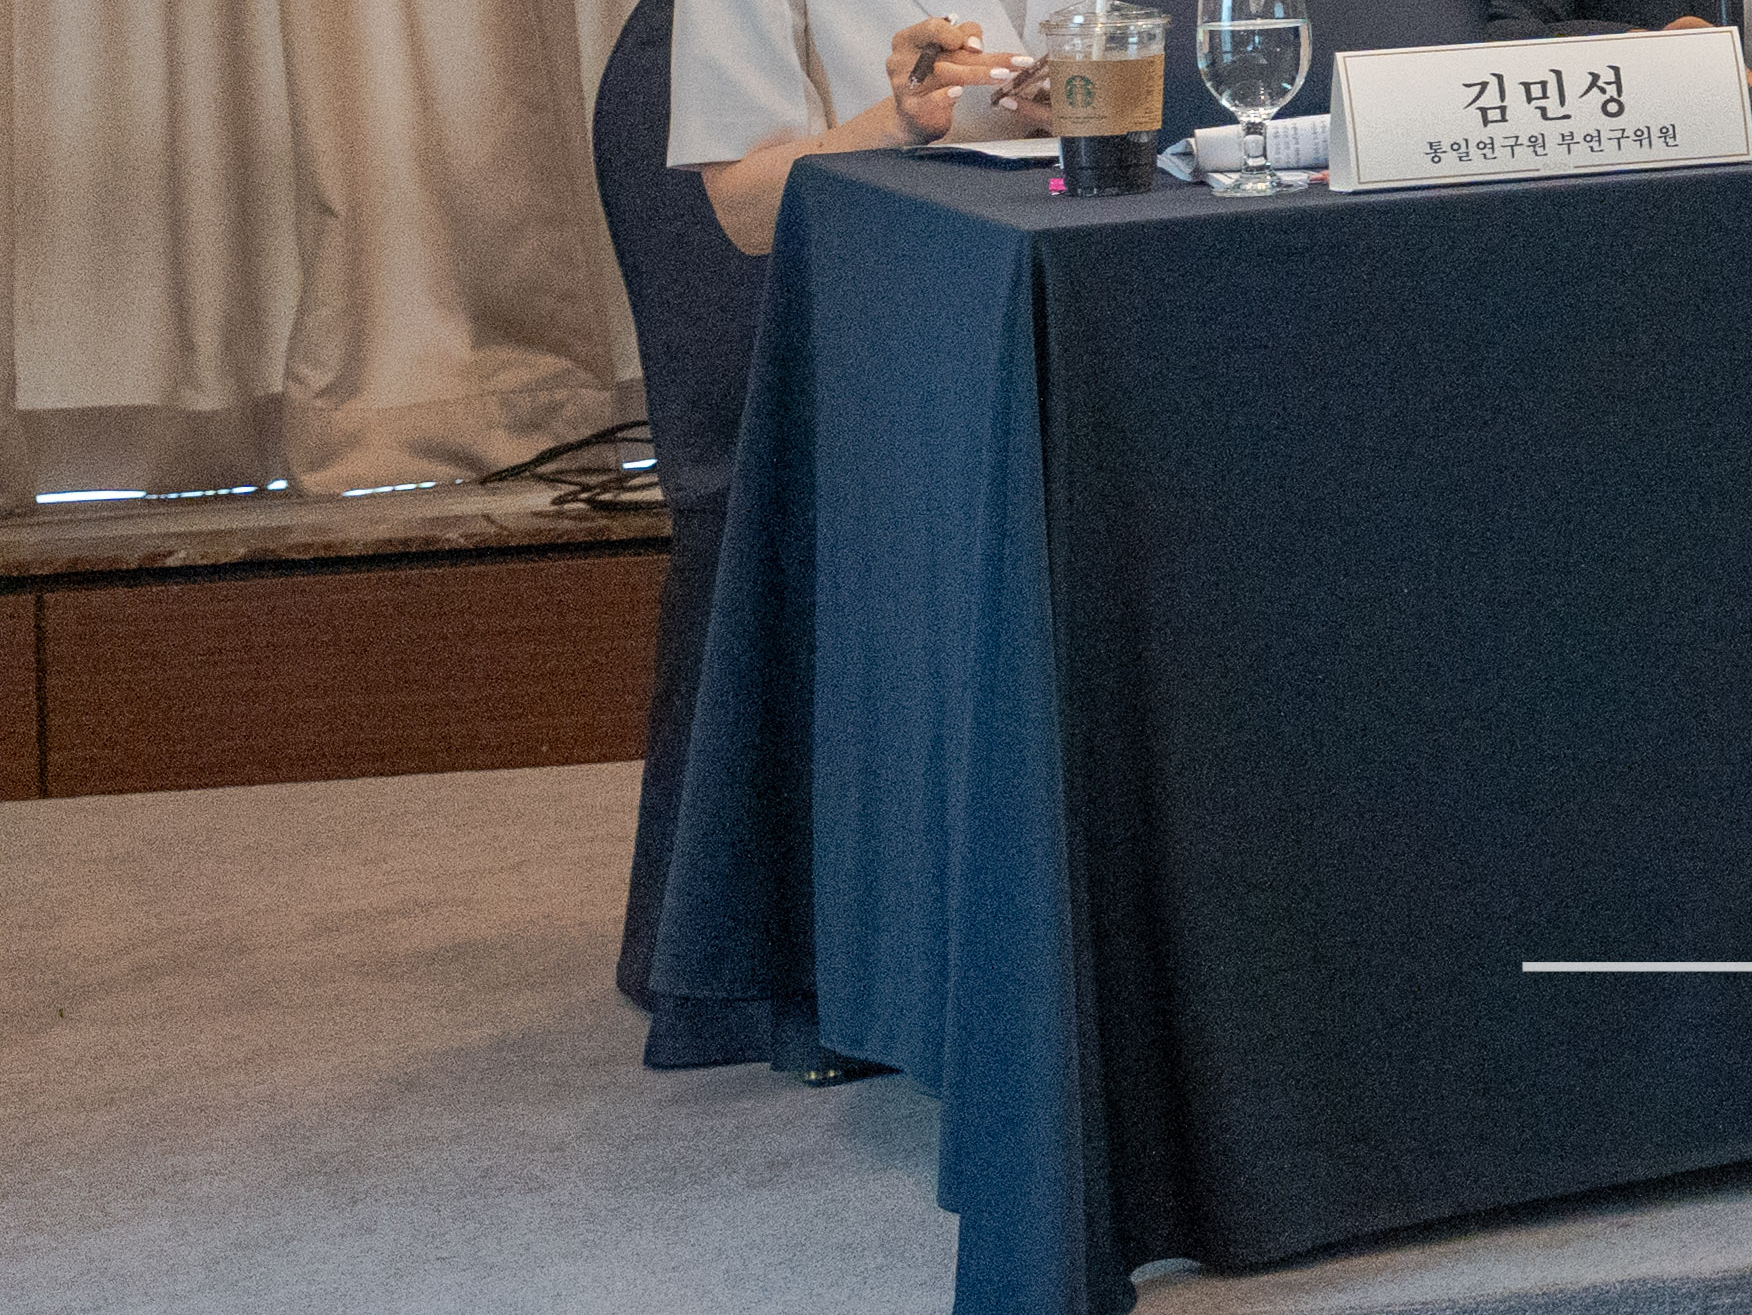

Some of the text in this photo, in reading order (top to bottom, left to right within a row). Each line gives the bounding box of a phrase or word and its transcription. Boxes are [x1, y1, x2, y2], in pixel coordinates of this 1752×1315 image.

[1462, 64, 1626, 129] 김민성
[1424, 123, 1680, 165] 통일연구원 부연구위원
